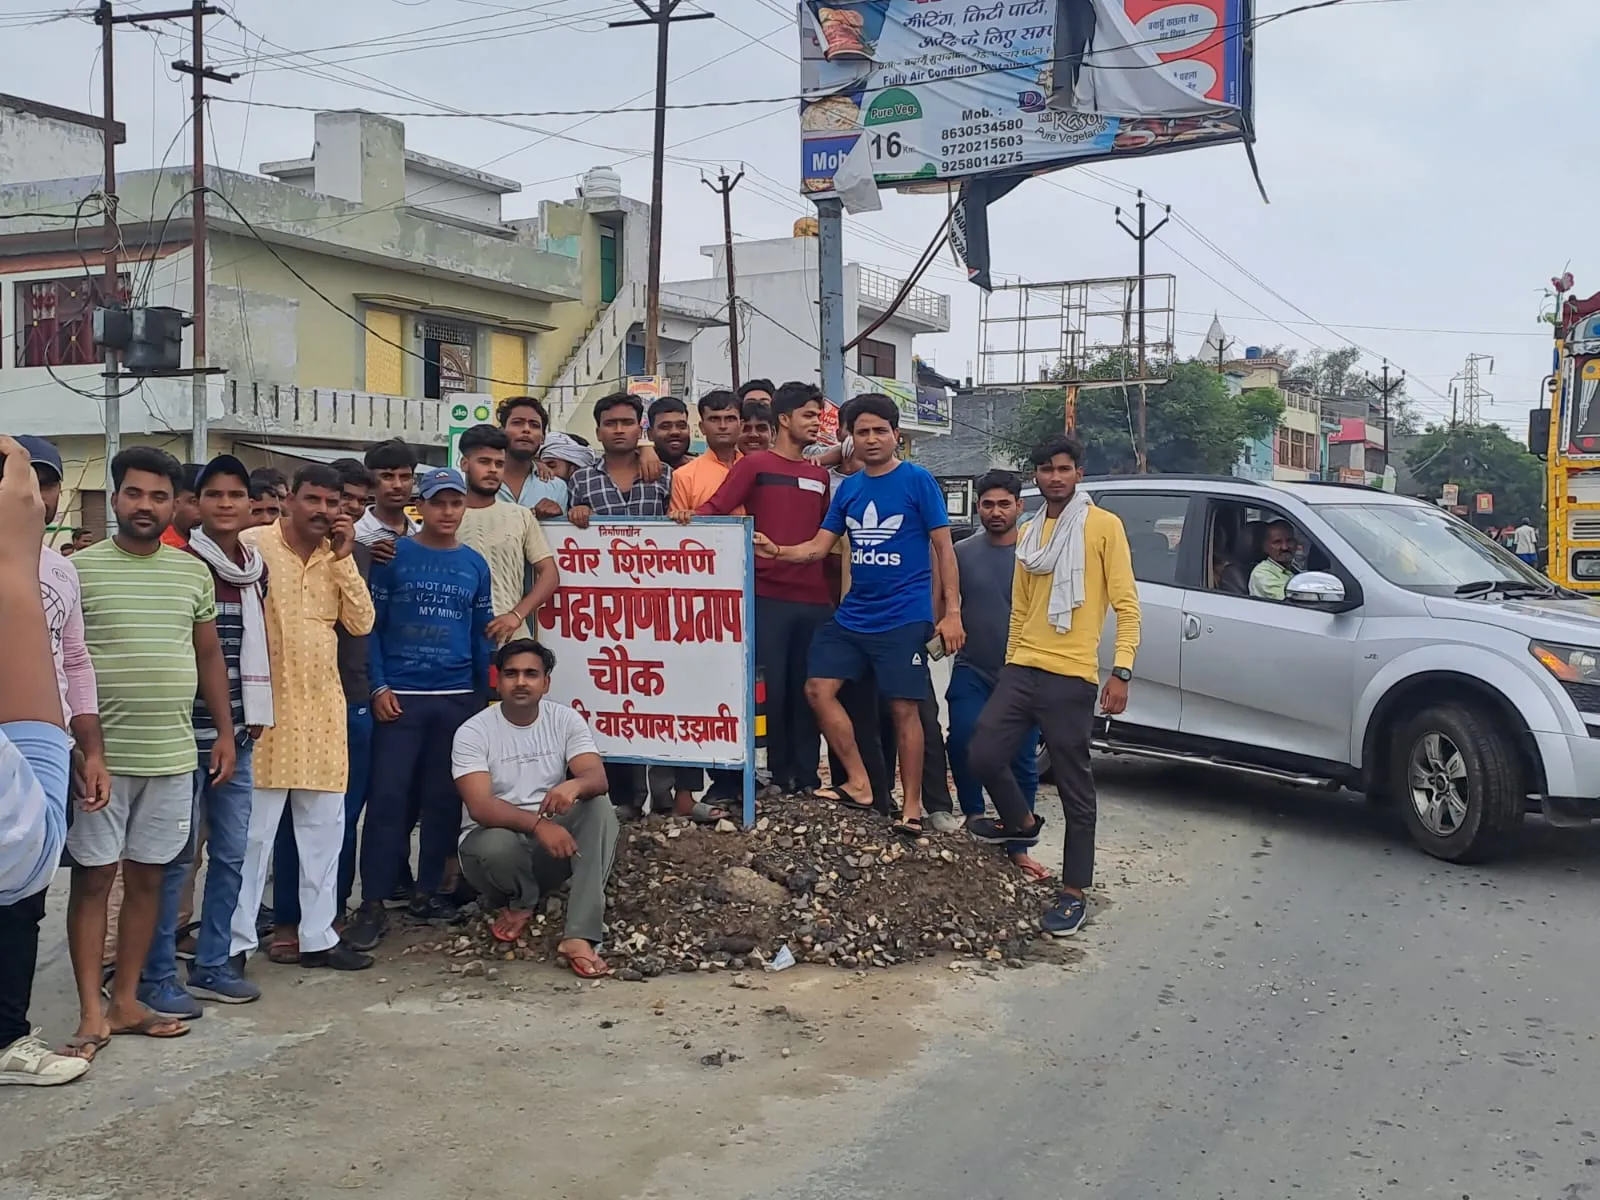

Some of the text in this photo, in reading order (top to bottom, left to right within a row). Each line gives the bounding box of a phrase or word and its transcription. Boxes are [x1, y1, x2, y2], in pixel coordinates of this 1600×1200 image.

[984, 27, 1016, 48] लिए
[883, 72, 907, 86] Fully
[911, 70, 925, 81] Air
[928, 64, 977, 79] Condition
[871, 104, 917, 118] Pure Veg.
[941, 118, 1024, 141] 8630534580
[1059, 121, 1111, 144] Vegetarian
[871, 131, 901, 160] 16
[941, 134, 1024, 157] 9720215603
[941, 151, 1024, 173] 9258014275
[557, 537, 716, 584] वीर शिरोमणि
[851, 548, 901, 566] didas
[416, 580, 440, 591] NOT
[418, 606, 463, 620] MY MIND
[538, 586, 743, 644] महाराणा प्रताप
[587, 645, 664, 696] चौक
[677, 703, 738, 749] उझानी
